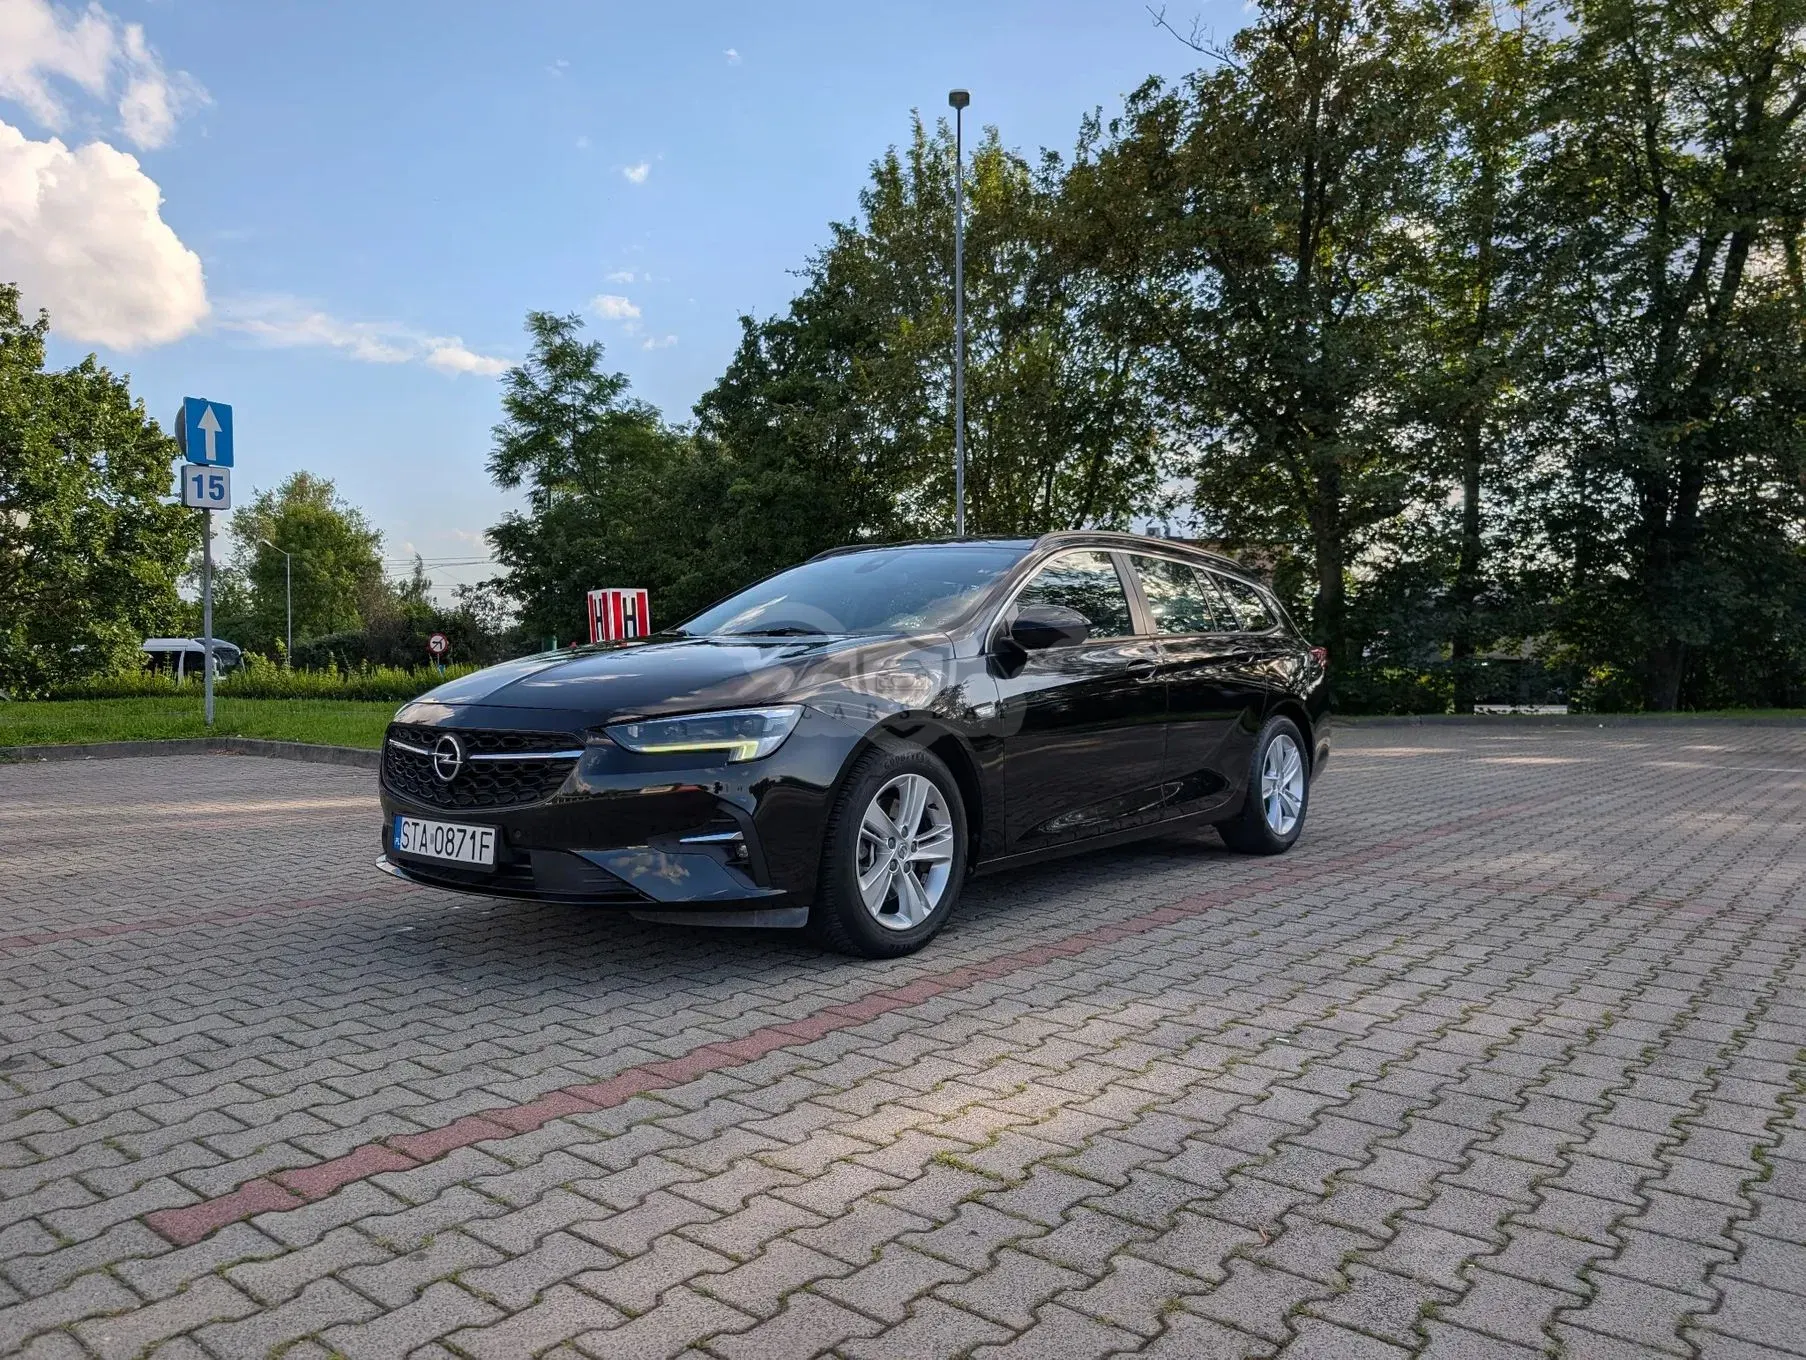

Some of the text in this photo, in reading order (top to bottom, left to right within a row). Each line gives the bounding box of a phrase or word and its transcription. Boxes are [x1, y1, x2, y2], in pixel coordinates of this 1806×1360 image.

[192, 474, 224, 500] 15
[623, 597, 637, 638] H
[401, 821, 492, 860] STA 0871F
